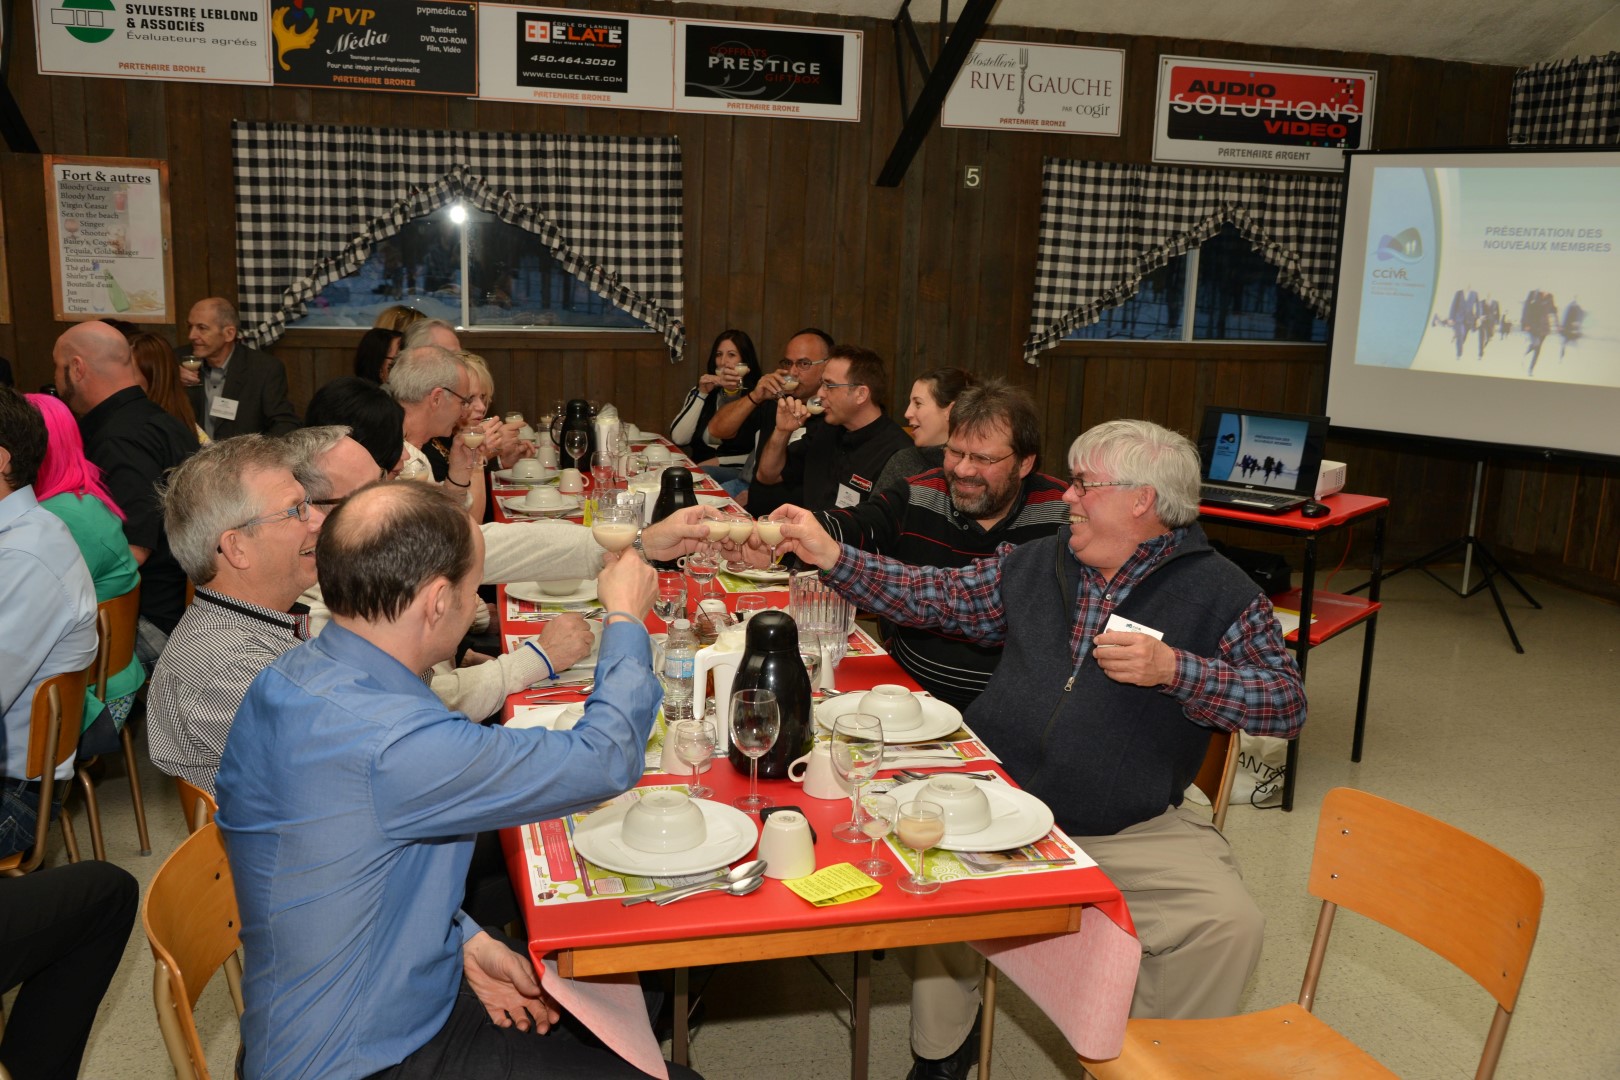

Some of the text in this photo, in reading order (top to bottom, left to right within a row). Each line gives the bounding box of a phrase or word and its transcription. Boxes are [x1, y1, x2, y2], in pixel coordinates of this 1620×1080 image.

[125, 4, 258, 22] SYLVESTRE LEBLOND
[326, 6, 376, 26] PVP
[416, 6, 468, 17] pvpmedia.ca
[126, 18, 205, 32] & ASSOCIÉS
[430, 26, 458, 34] Transfert
[126, 31, 257, 47] Évaluateurs agréés
[420, 35, 468, 45] DVD, CD-ROM
[552, 26, 622, 43] ELATE
[326, 29, 390, 55] Média
[426, 45, 461, 54] Film, Vidéo
[709, 46, 767, 58] COFFRETS
[530, 55, 616, 66] 450.464.3030
[708, 56, 821, 75] PRESTIGE
[965, 52, 1017, 68] Hostellerie
[118, 62, 206, 73] PARTENAIRE BRONZE
[326, 62, 341, 70] Pour
[354, 63, 373, 71] image
[374, 65, 420, 73] professionnelle
[332, 75, 416, 87] PARTENAIRE BRONZE
[522, 71, 623, 82] WWW.ECOLEELATE.COM
[765, 74, 820, 85] GIFTBOX
[970, 71, 1112, 97] RIVE GAUCHE
[1188, 79, 1276, 98] AUDIO
[533, 90, 580, 100] PARTENAIRE
[727, 102, 800, 112] PARTENAIRE BRONZE
[1076, 104, 1110, 118] cogir
[1173, 93, 1359, 123] SOLUTIONS
[1000, 117, 1039, 126] PARTENAIRE
[1264, 120, 1348, 138] VIDEO
[1218, 148, 1310, 161] PARTENAIRE ARGENT
[62, 170, 151, 183] Fort & autres
[966, 168, 980, 186] 5
[60, 183, 85, 191] Bloody
[60, 193, 105, 202] Bloody Mary
[61, 201, 83, 210] Virgin
[80, 220, 104, 228] Stinger
[1485, 226, 1602, 239] PRÉSENTATION DES
[64, 247, 93, 255] Tequila,
[1483, 240, 1612, 253] NOUVEAUX MEMBRES
[66, 273, 88, 281] Shirley
